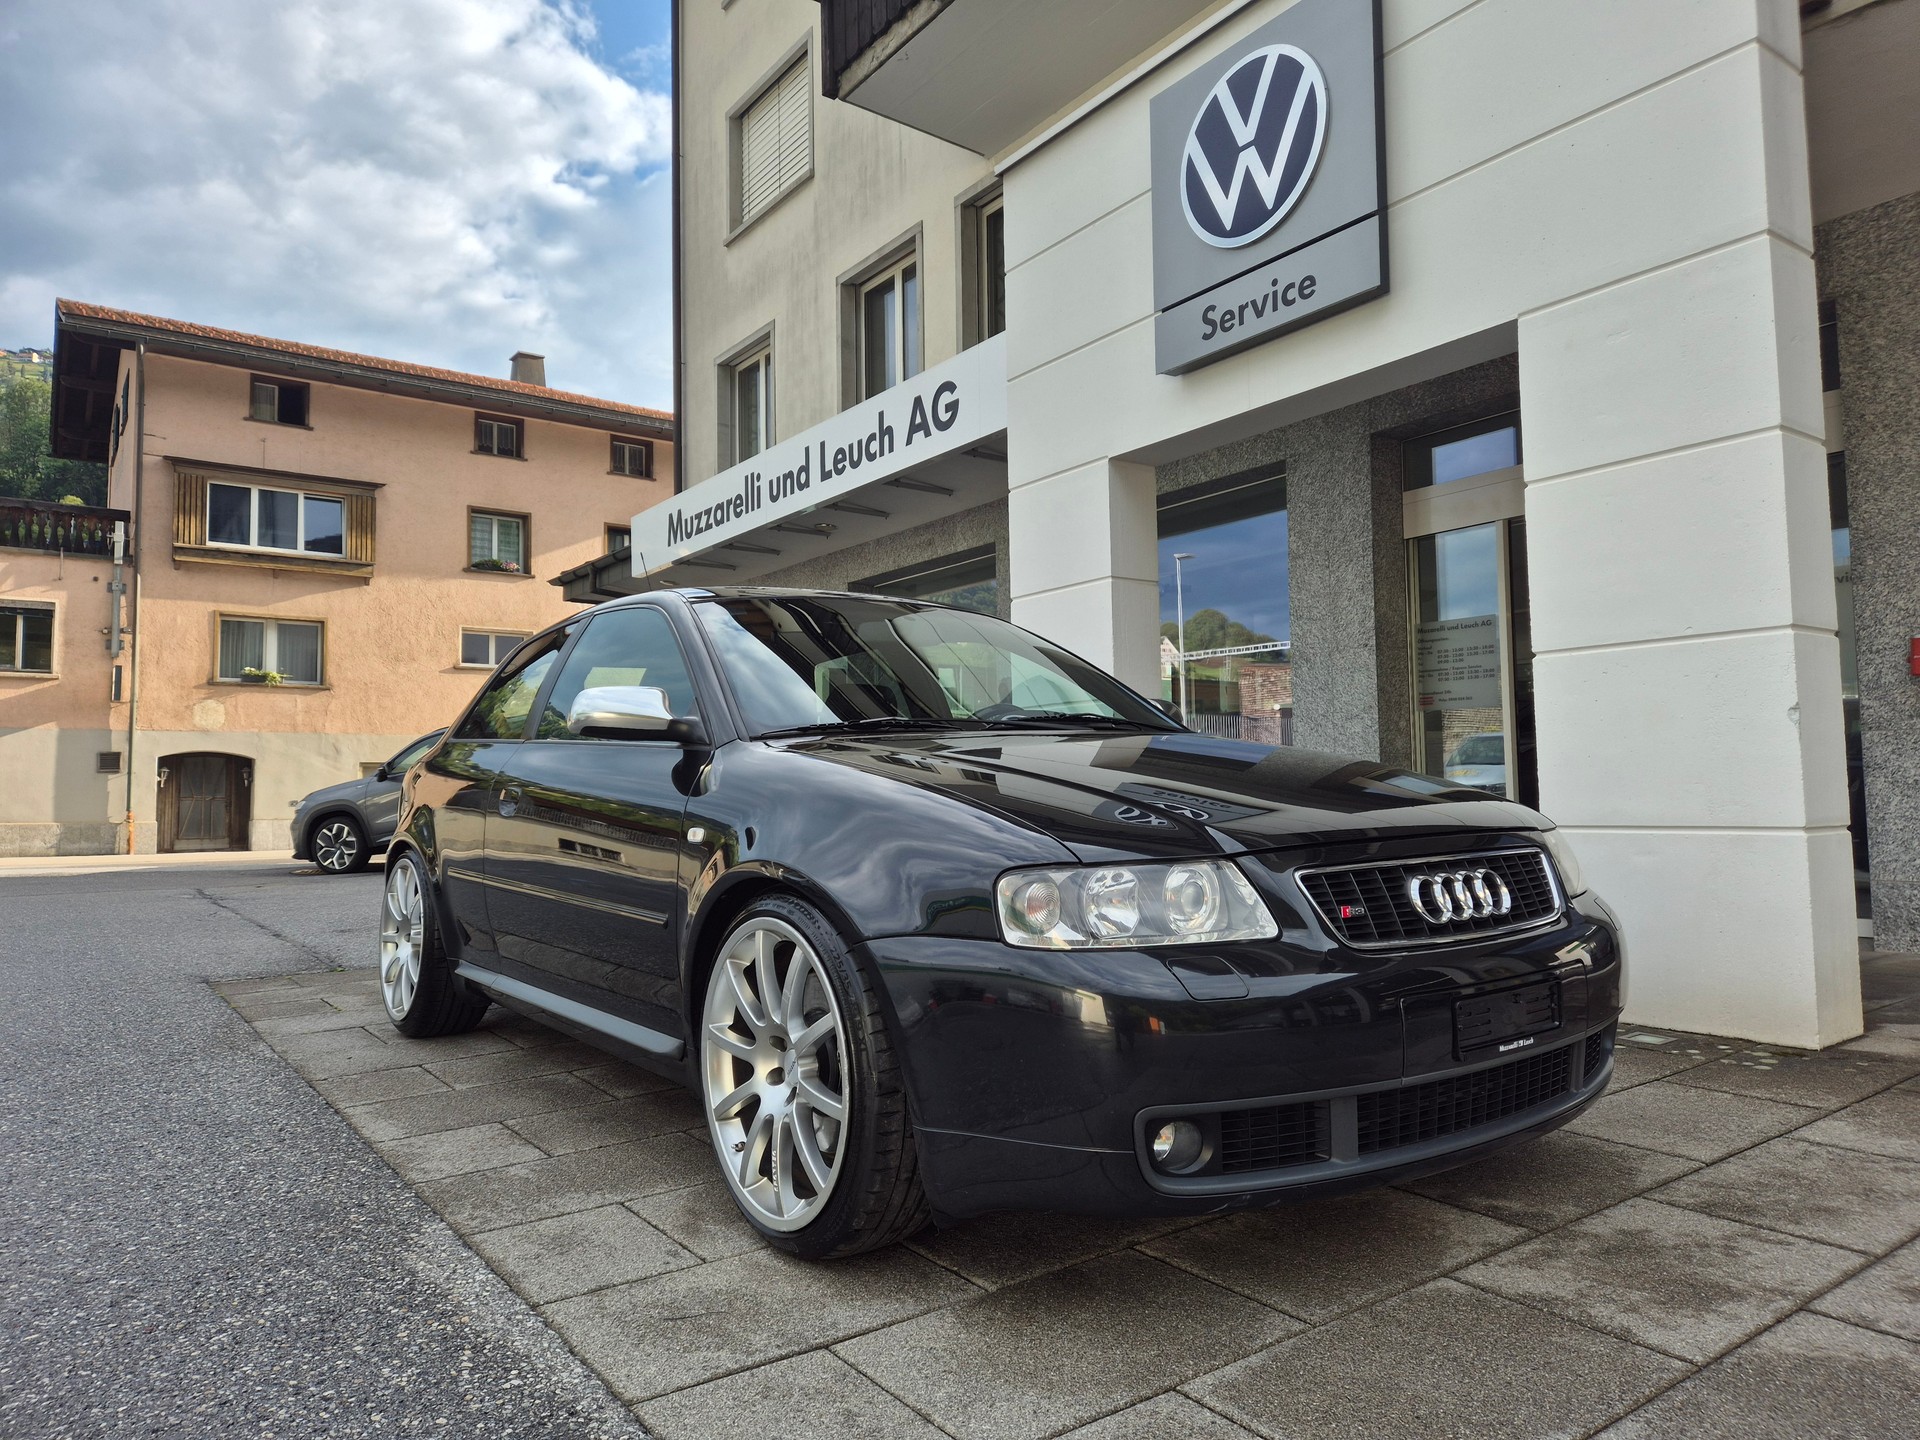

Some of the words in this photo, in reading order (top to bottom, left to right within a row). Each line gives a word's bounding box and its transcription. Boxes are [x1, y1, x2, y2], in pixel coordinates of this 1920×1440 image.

[1202, 275, 1317, 341] Service
[667, 472, 762, 547] Muzzarelli
[769, 446, 810, 503] und
[820, 411, 894, 482] Leuch
[906, 380, 960, 446] AG
